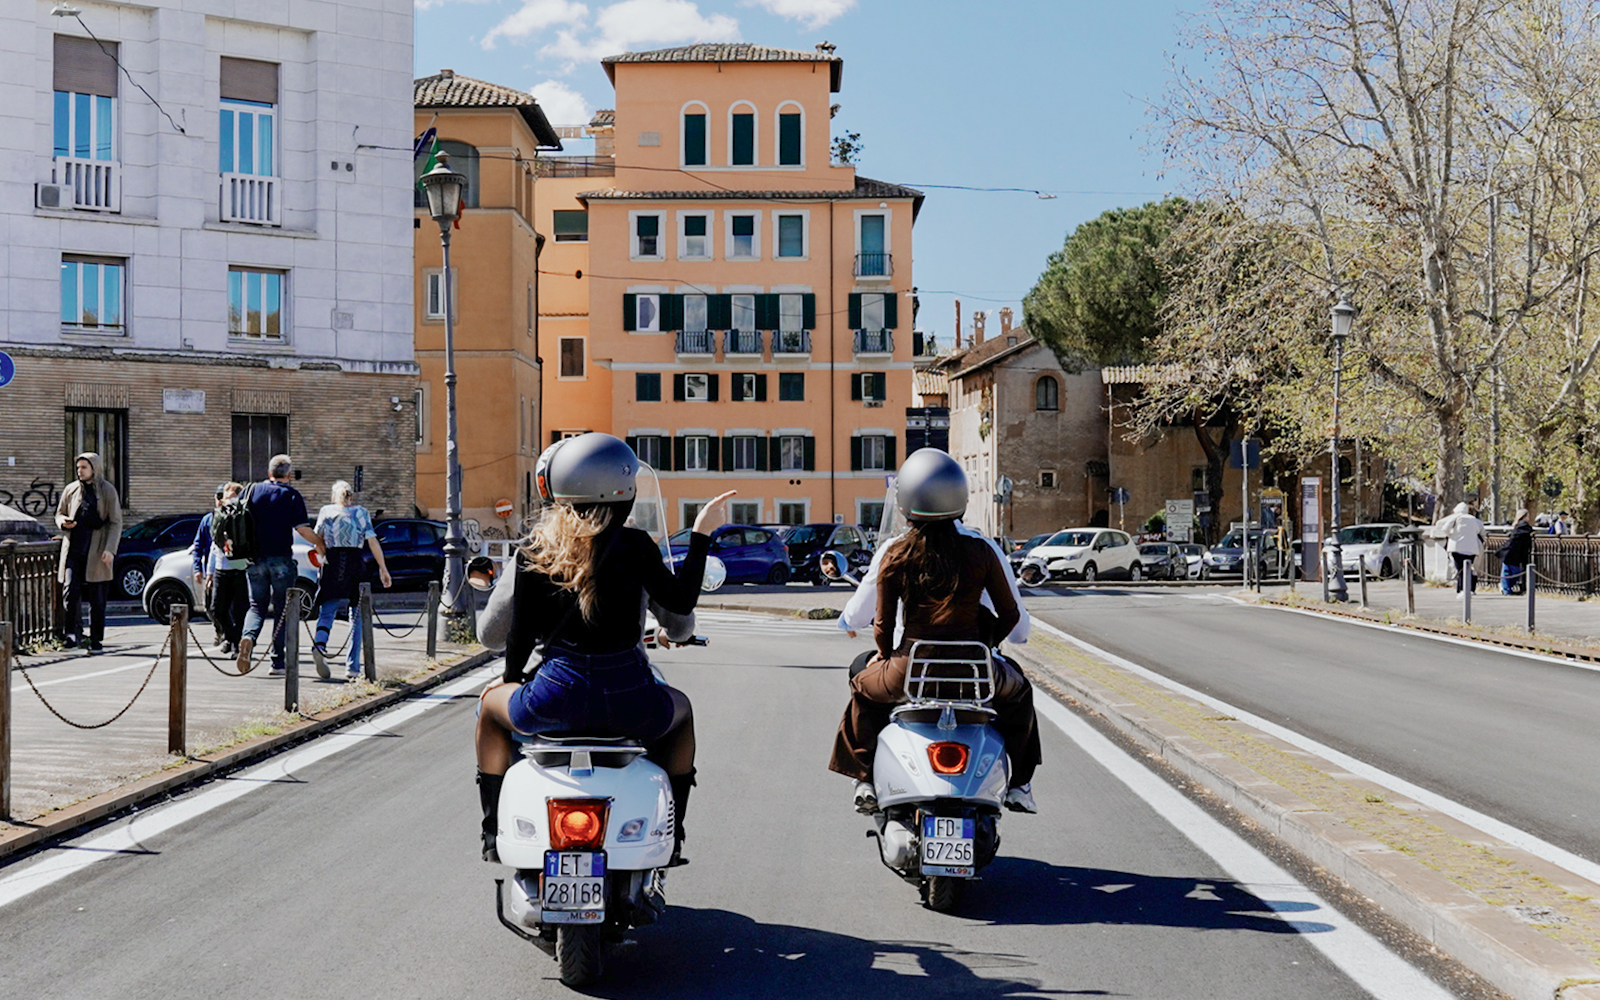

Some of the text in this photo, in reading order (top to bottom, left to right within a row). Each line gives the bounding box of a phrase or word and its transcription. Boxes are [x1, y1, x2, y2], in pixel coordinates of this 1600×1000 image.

[937, 818, 955, 837] FD
[926, 842, 972, 861] 67256
[561, 854, 582, 875] ET
[547, 882, 601, 904] 28168
